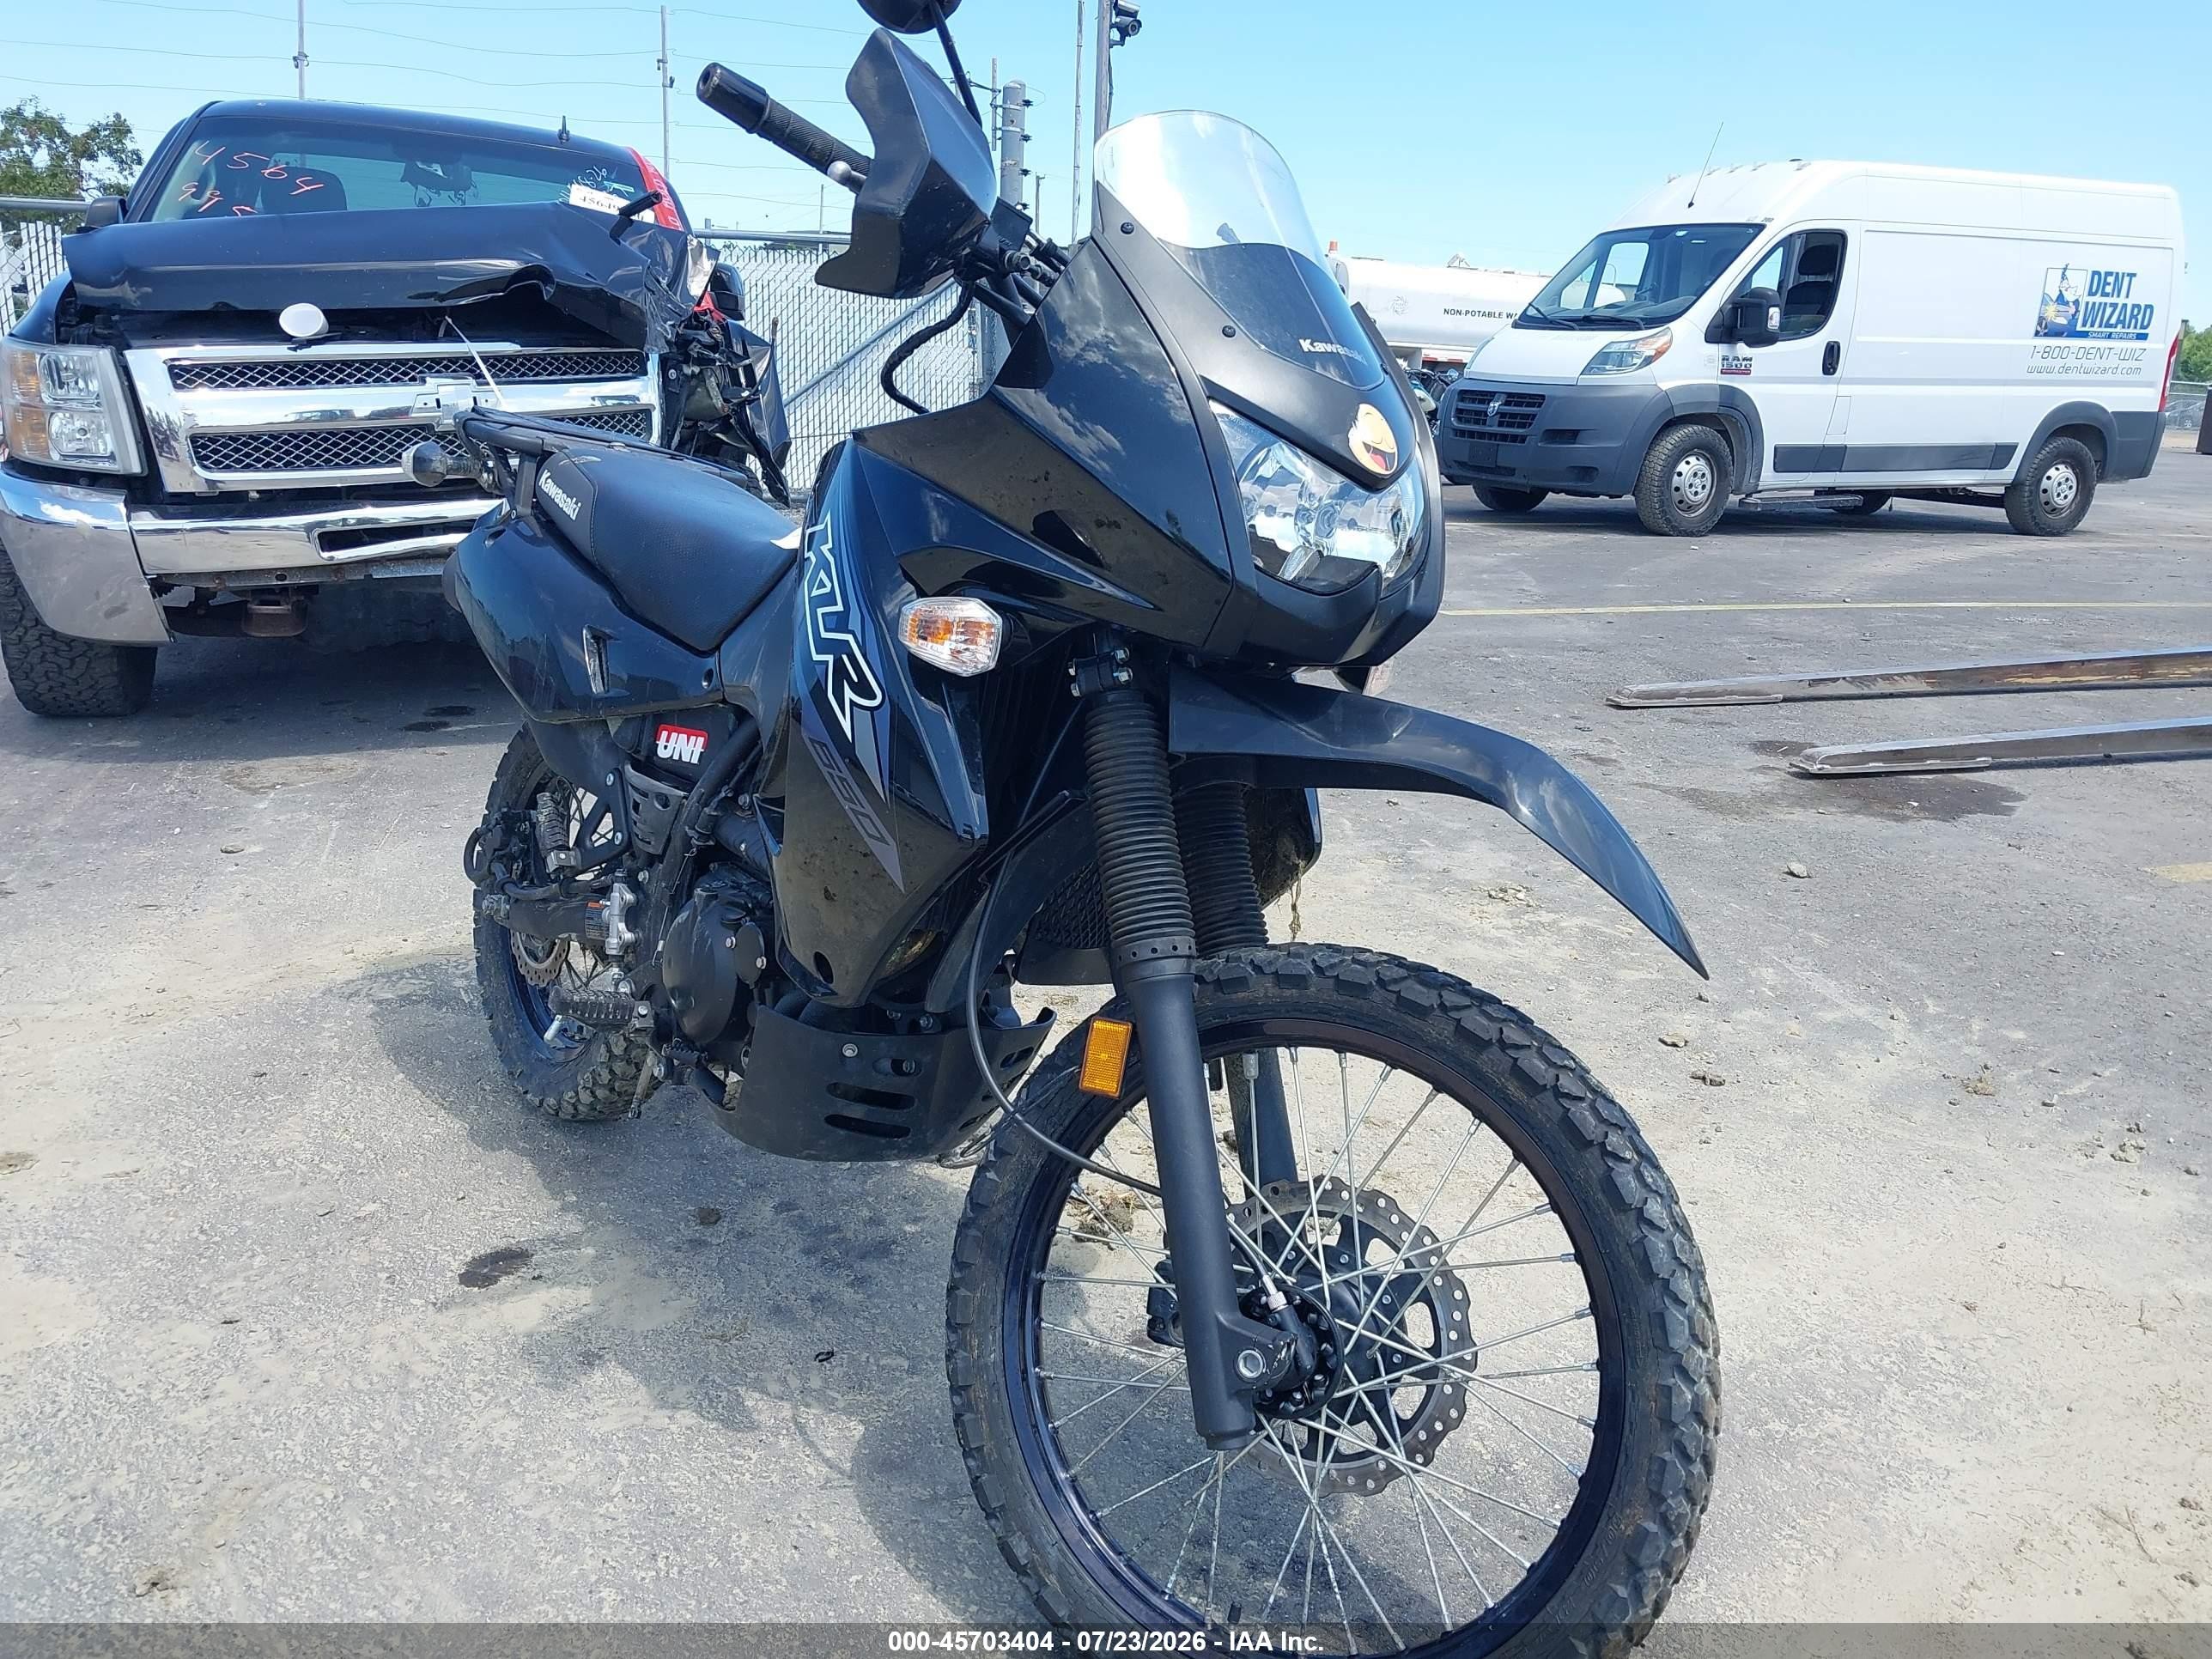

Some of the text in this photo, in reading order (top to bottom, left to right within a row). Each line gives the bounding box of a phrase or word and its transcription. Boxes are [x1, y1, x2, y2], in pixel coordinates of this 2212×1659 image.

[2087, 270, 2136, 298] DENT
[1443, 307, 1504, 319] NON-POTABLE
[2081, 301, 2154, 330] WIZARD
[2087, 331, 2137, 340] SMART REPAIRS
[2030, 344, 2148, 362] 1-800-DENT-WIZ
[2026, 362, 2142, 376] www.dentwizard.com
[538, 468, 582, 521] Kawasaki
[803, 507, 884, 744] KLR
[655, 730, 705, 765] UNI
[807, 736, 891, 847] 650
